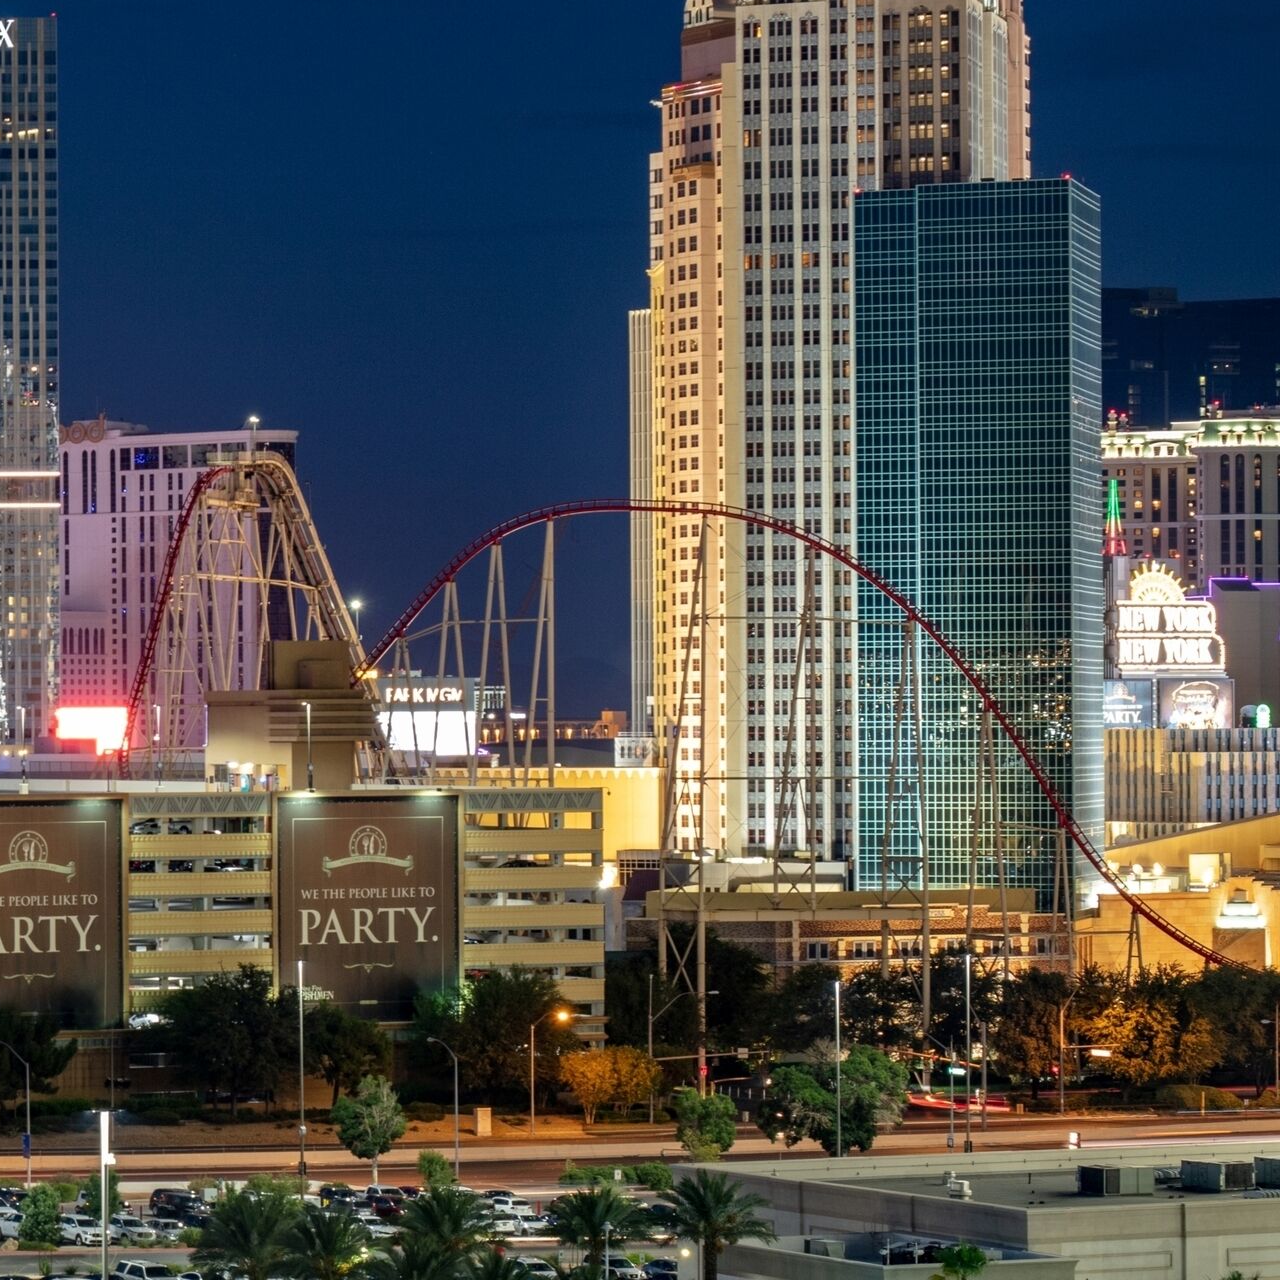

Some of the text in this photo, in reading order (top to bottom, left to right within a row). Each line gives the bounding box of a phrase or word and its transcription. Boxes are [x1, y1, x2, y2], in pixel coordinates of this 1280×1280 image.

[1119, 606, 1212, 632] NEW YORK
[1119, 638, 1213, 663] NEW YORK
[8, 895, 49, 907] PEOPLE
[52, 894, 78, 906] LIKE
[80, 894, 98, 905] TO
[301, 886, 435, 900] WE THE PEOPLE LIKE TO
[298, 906, 438, 946] PARTY.
